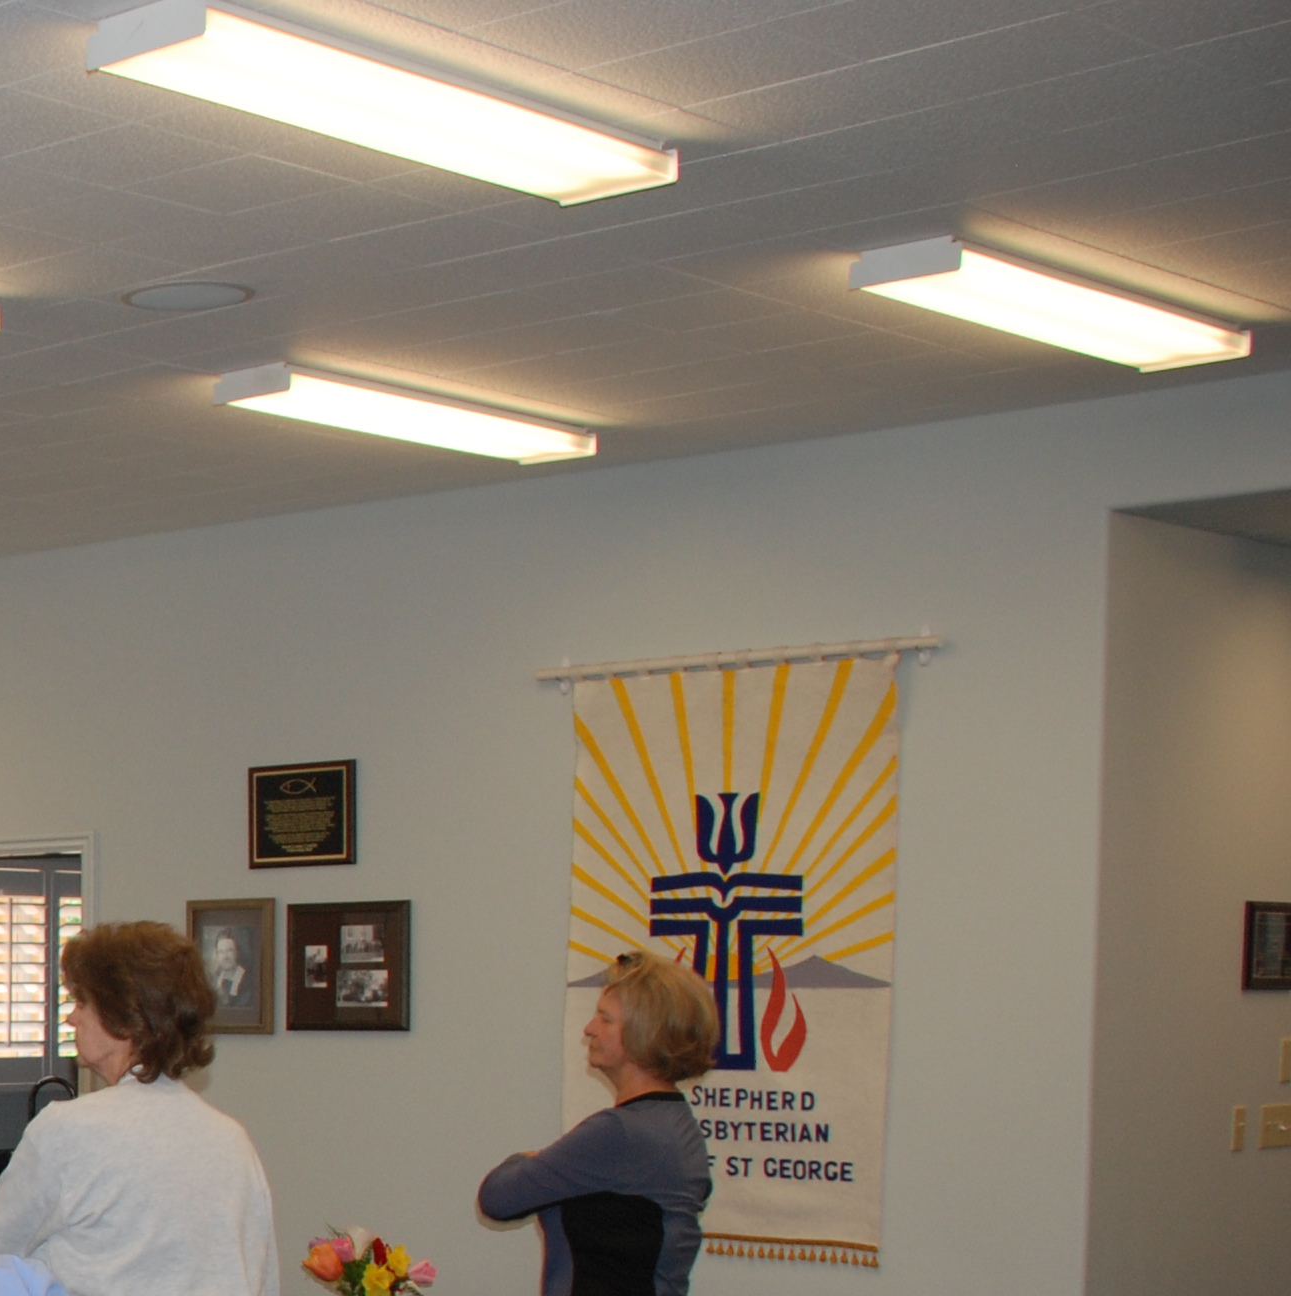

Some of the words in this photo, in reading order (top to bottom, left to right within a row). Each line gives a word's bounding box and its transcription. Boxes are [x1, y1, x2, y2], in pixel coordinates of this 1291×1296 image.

[690, 1085, 815, 1111] SHEPHERD
[700, 1119, 830, 1143] SBYTERIAN
[726, 1156, 753, 1177] ST
[763, 1157, 854, 1182] GEORGE
